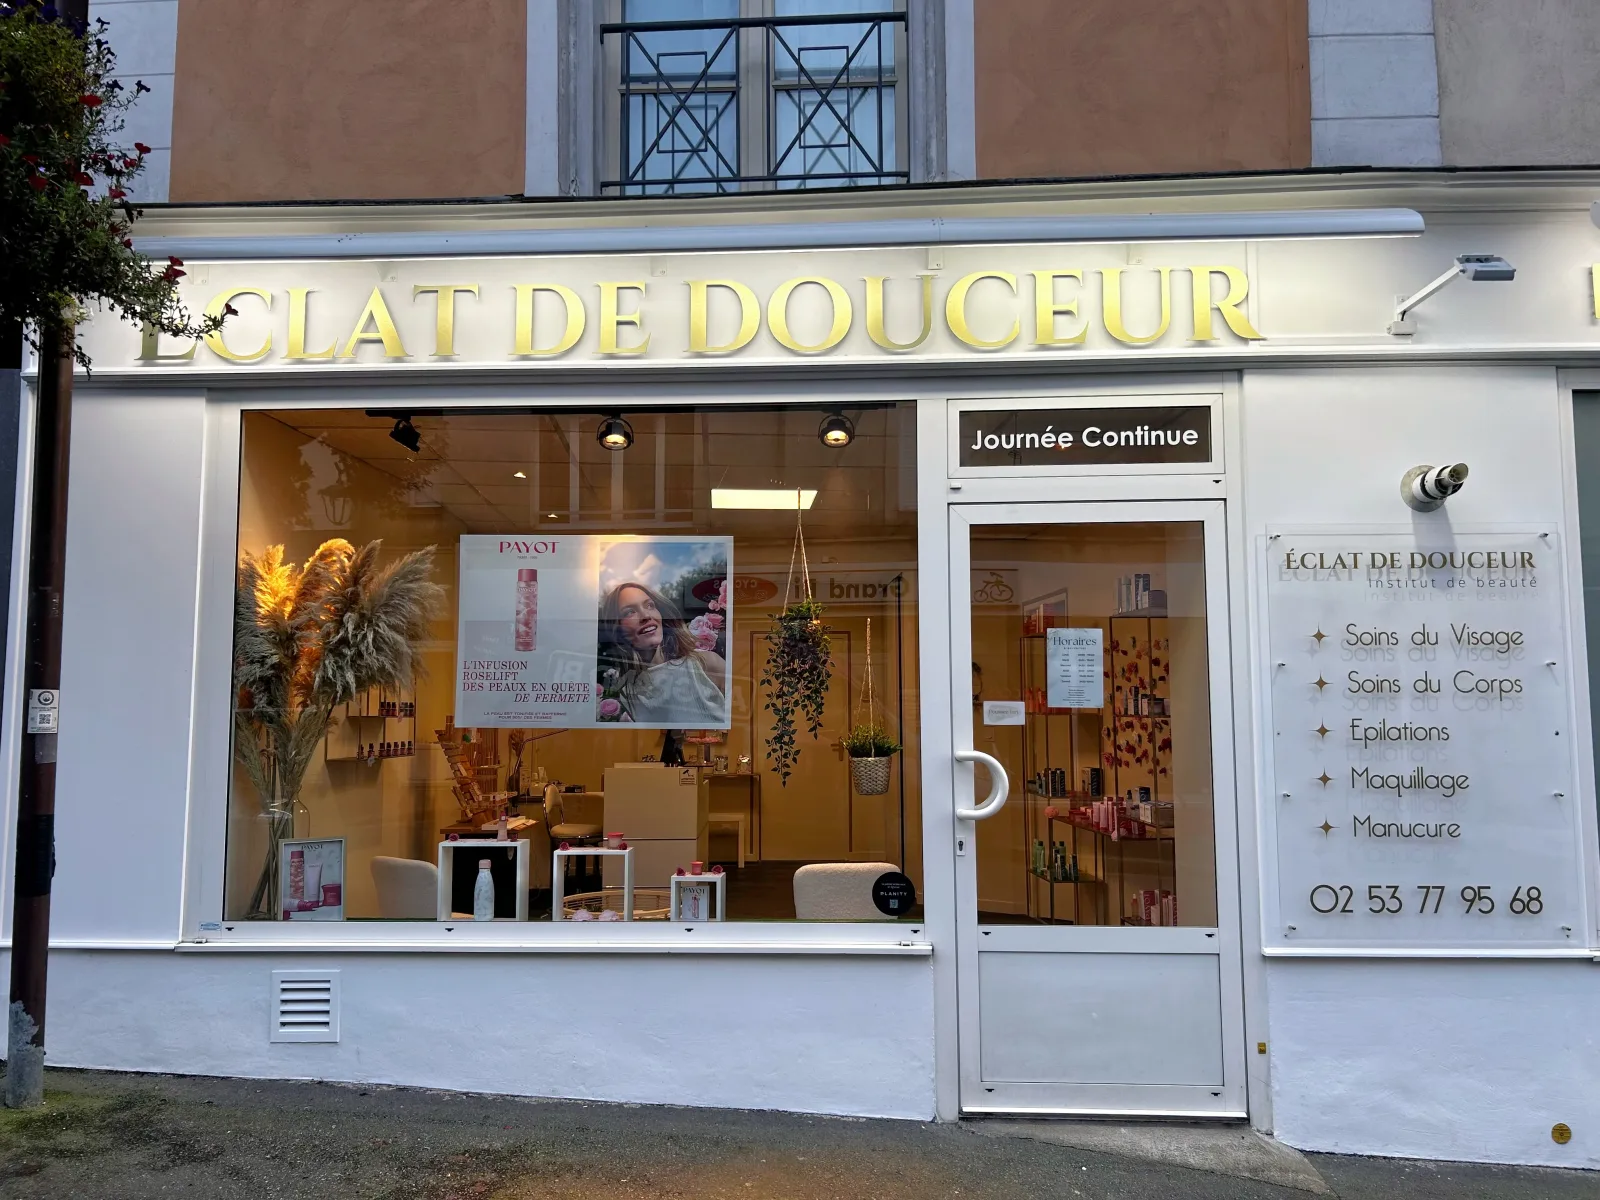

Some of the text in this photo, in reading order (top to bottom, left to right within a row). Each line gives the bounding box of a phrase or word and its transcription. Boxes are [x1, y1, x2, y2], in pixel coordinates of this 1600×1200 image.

[508, 281, 652, 356] DE
[682, 265, 1268, 352] DOUCEUR
[971, 424, 1199, 450] Journée Continue
[499, 541, 560, 554] PAYOT
[1285, 548, 1537, 570] ÉCLAT DE DOUCEUR
[1368, 575, 1538, 589] Institut de beauté
[1053, 636, 1097, 646] Horaires
[1346, 623, 1525, 654] Soins du Visage
[462, 671, 519, 681] ROSELIFT
[463, 660, 528, 670] L'INFUSION
[462, 680, 590, 693] DES PEAUX EN QUÊTE
[1348, 670, 1524, 702] Soins du Corps
[514, 693, 530, 703] DE
[1350, 718, 1450, 749] Epilations
[1351, 767, 1470, 797] Maquillage
[1353, 815, 1461, 838] Manucure
[1310, 884, 1544, 915] 02 53 77 95 68
